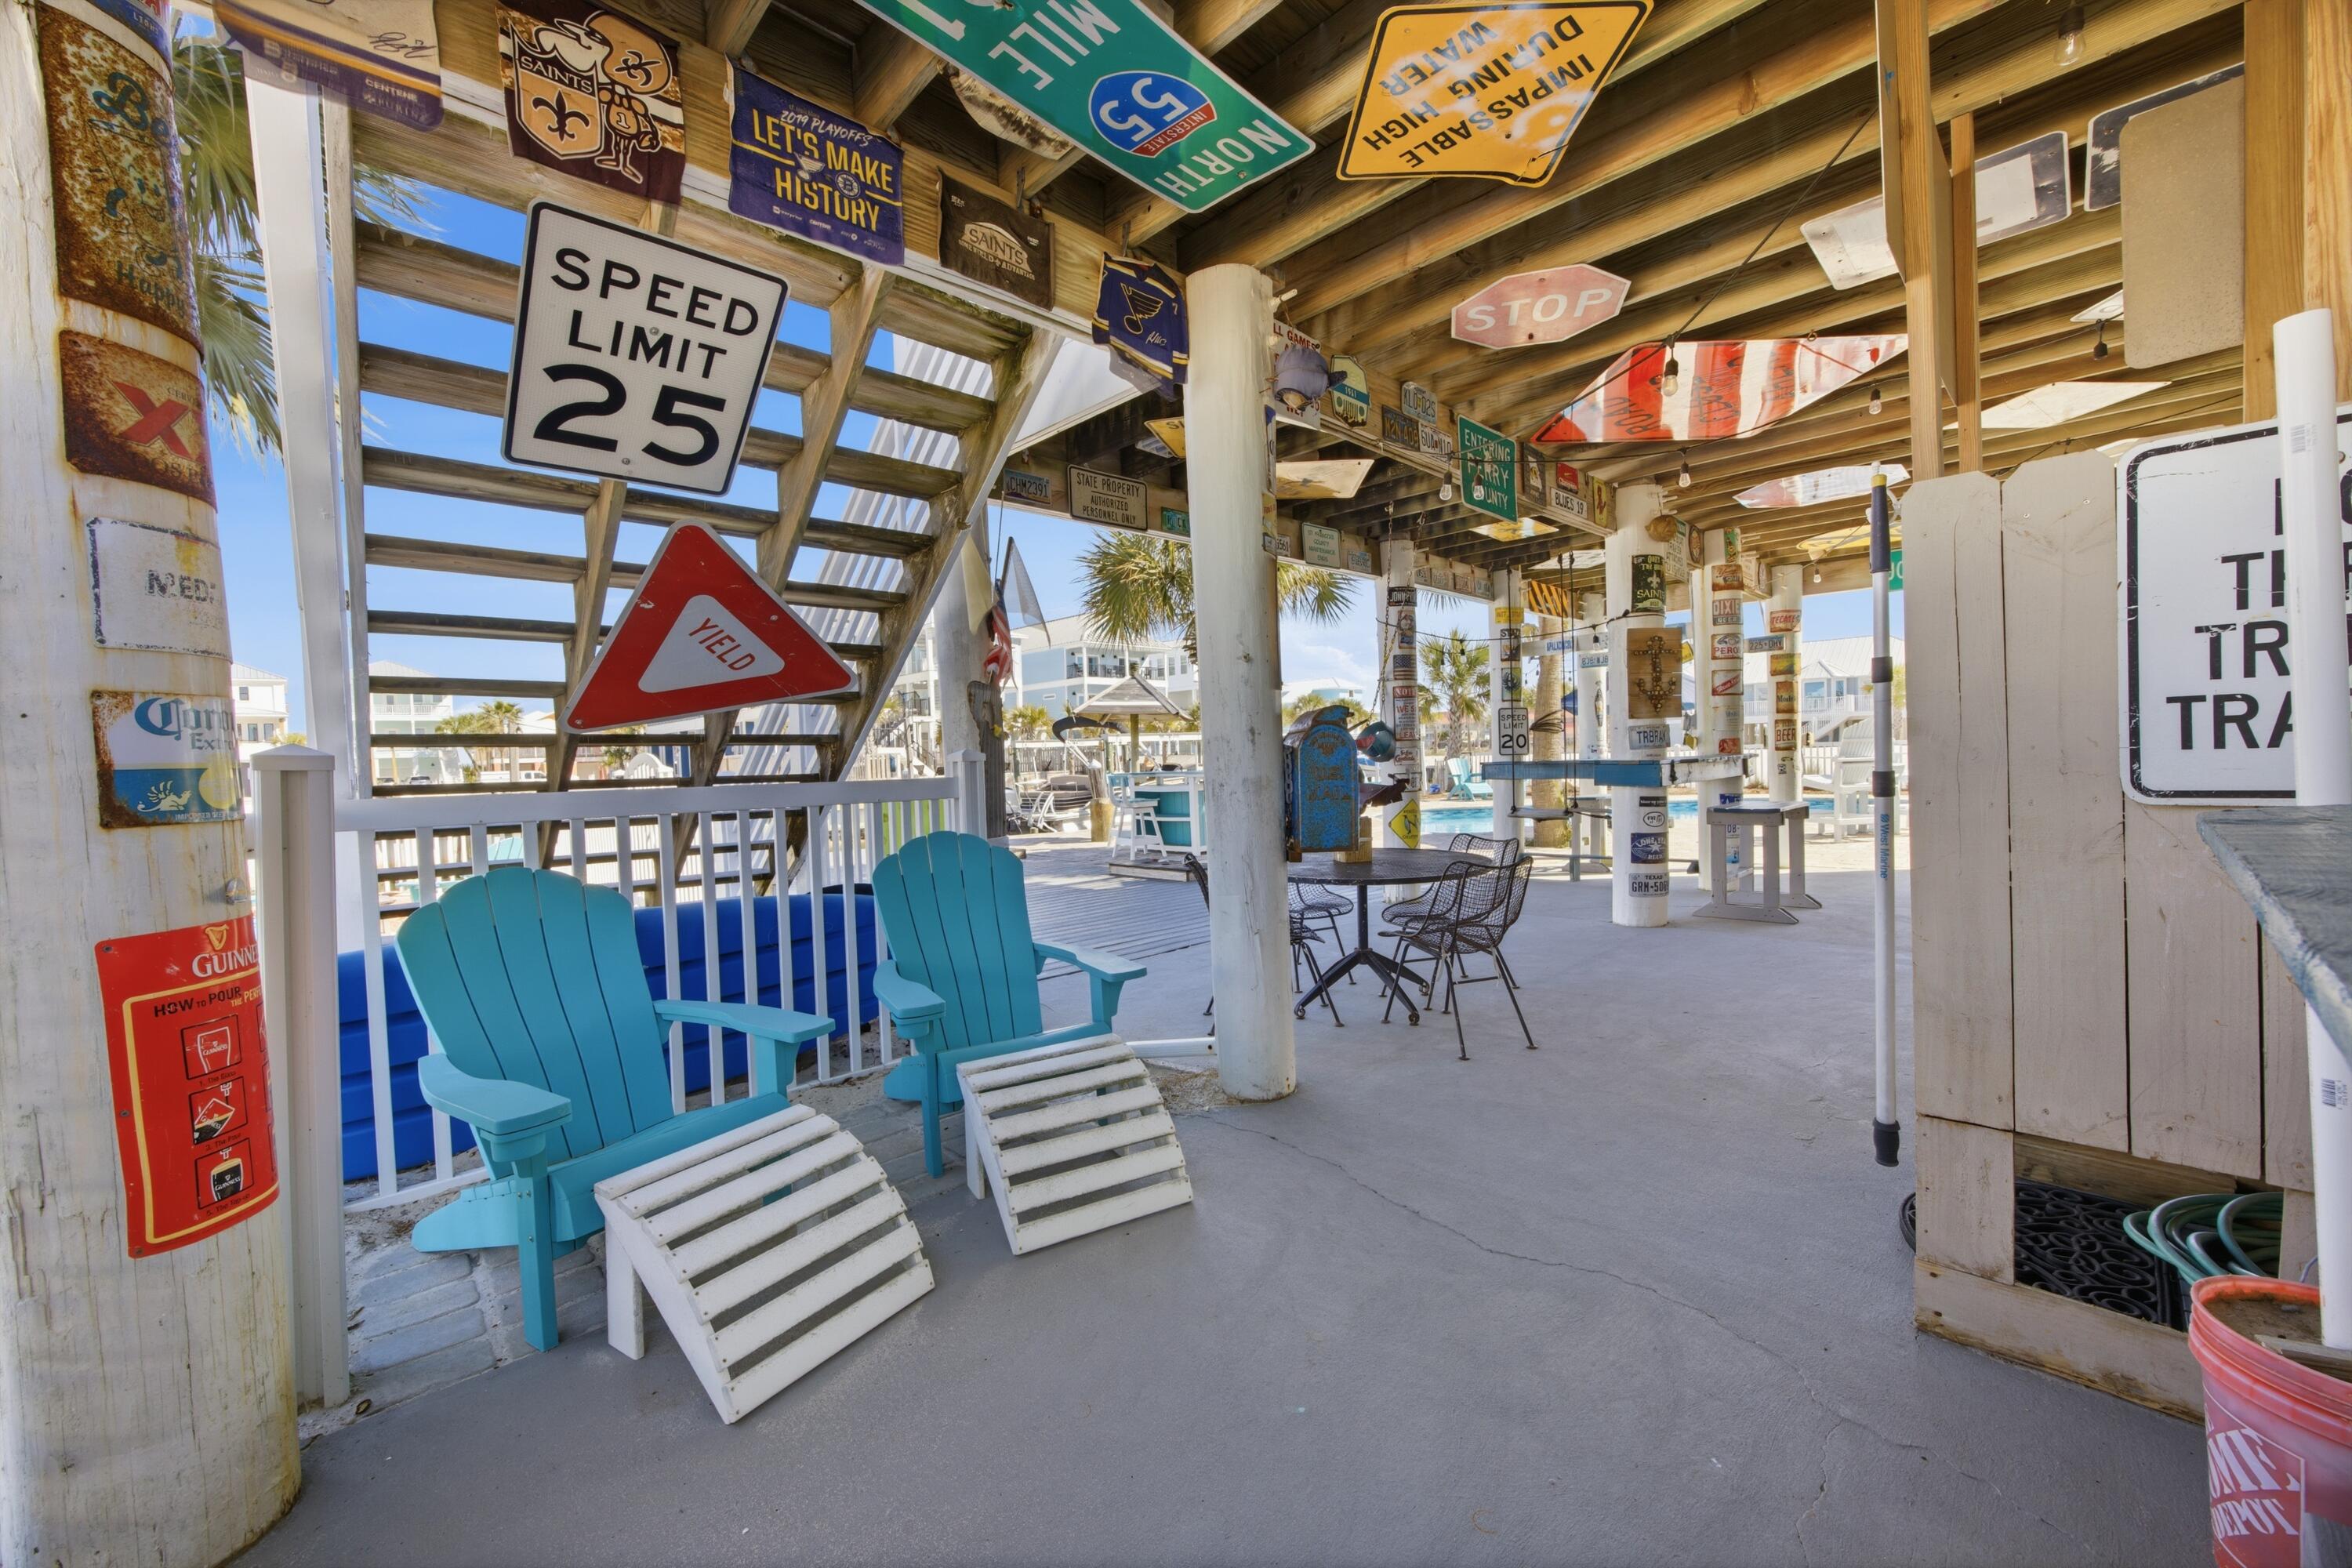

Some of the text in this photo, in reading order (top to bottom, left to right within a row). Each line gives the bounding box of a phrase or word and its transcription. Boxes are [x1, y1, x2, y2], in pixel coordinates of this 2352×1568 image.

[988, 0, 1121, 91] MILE
[1378, 20, 1497, 97] WATER
[521, 56, 593, 94] SAINTS
[1362, 14, 1584, 151] DURING HIGH
[780, 110, 808, 127] 2019
[811, 118, 873, 147] PLAYOFFS
[1099, 77, 1189, 142] 55
[1398, 53, 1595, 168] IMPASSABLE
[752, 108, 895, 194] LET'S MAKE
[1143, 111, 1209, 154] INTERSTATE
[1154, 118, 1292, 198] NORTH
[775, 167, 880, 232] HISTORY
[969, 227, 1025, 266] SAINTS
[550, 247, 759, 336] SPEED
[1464, 287, 1613, 332] STOP
[568, 309, 728, 379] LIMIT
[532, 363, 728, 467] 25
[1464, 428, 1512, 462] ENTERING
[1076, 472, 1141, 498] STATE PROPERTY
[1467, 452, 1509, 490] PRRY
[1083, 505, 1136, 525] PERSONNEL ONLY
[1091, 495, 1129, 512] AUTHORIZED
[1555, 492, 1575, 512] BLUES
[1713, 599, 1740, 616] DIXIE
[688, 617, 757, 671] YIELD
[1501, 734, 1527, 749] 20
[1776, 728, 1795, 742] BEER
[1880, 823, 1890, 879] West Marine
[154, 986, 242, 1018] HOW TO POUR
[230, 997, 243, 1007] THE
[208, 1074, 220, 1084] The
[215, 1138, 226, 1149] The
[215, 1176, 241, 1191] GUINNESS
[216, 1203, 228, 1213] The
